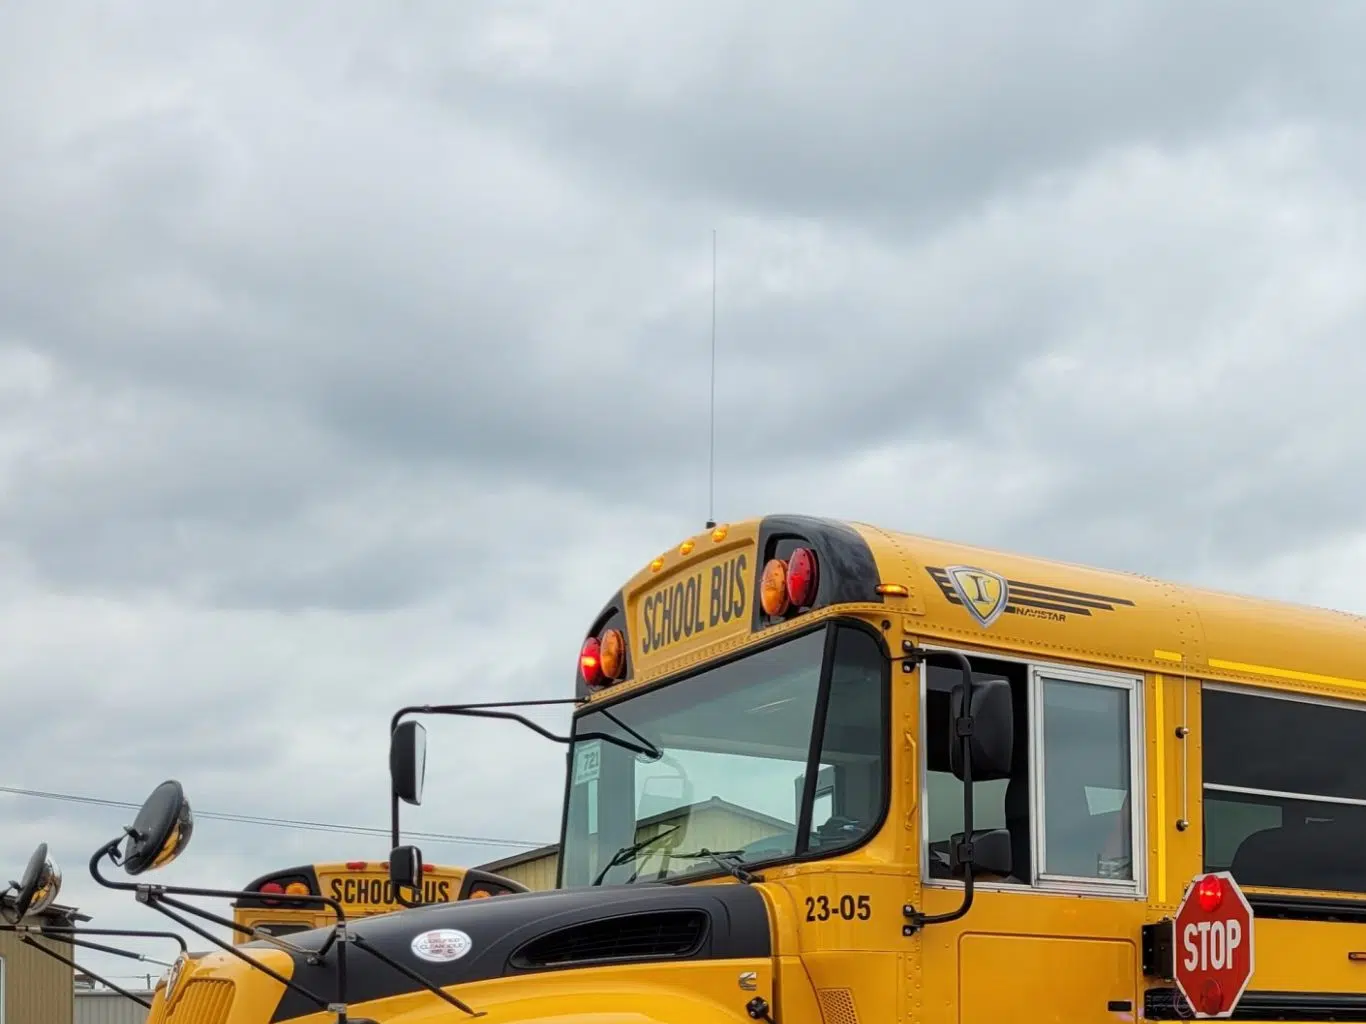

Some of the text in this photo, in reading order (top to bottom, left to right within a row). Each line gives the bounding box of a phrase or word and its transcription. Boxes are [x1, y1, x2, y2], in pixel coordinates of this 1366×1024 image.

[642, 553, 747, 655] SCHOOL BUS
[1015, 605, 1066, 622] NAVISTAR
[330, 878, 395, 904] SCHOO
[805, 894, 871, 922] 23-05
[1184, 919, 1242, 972] STOP
